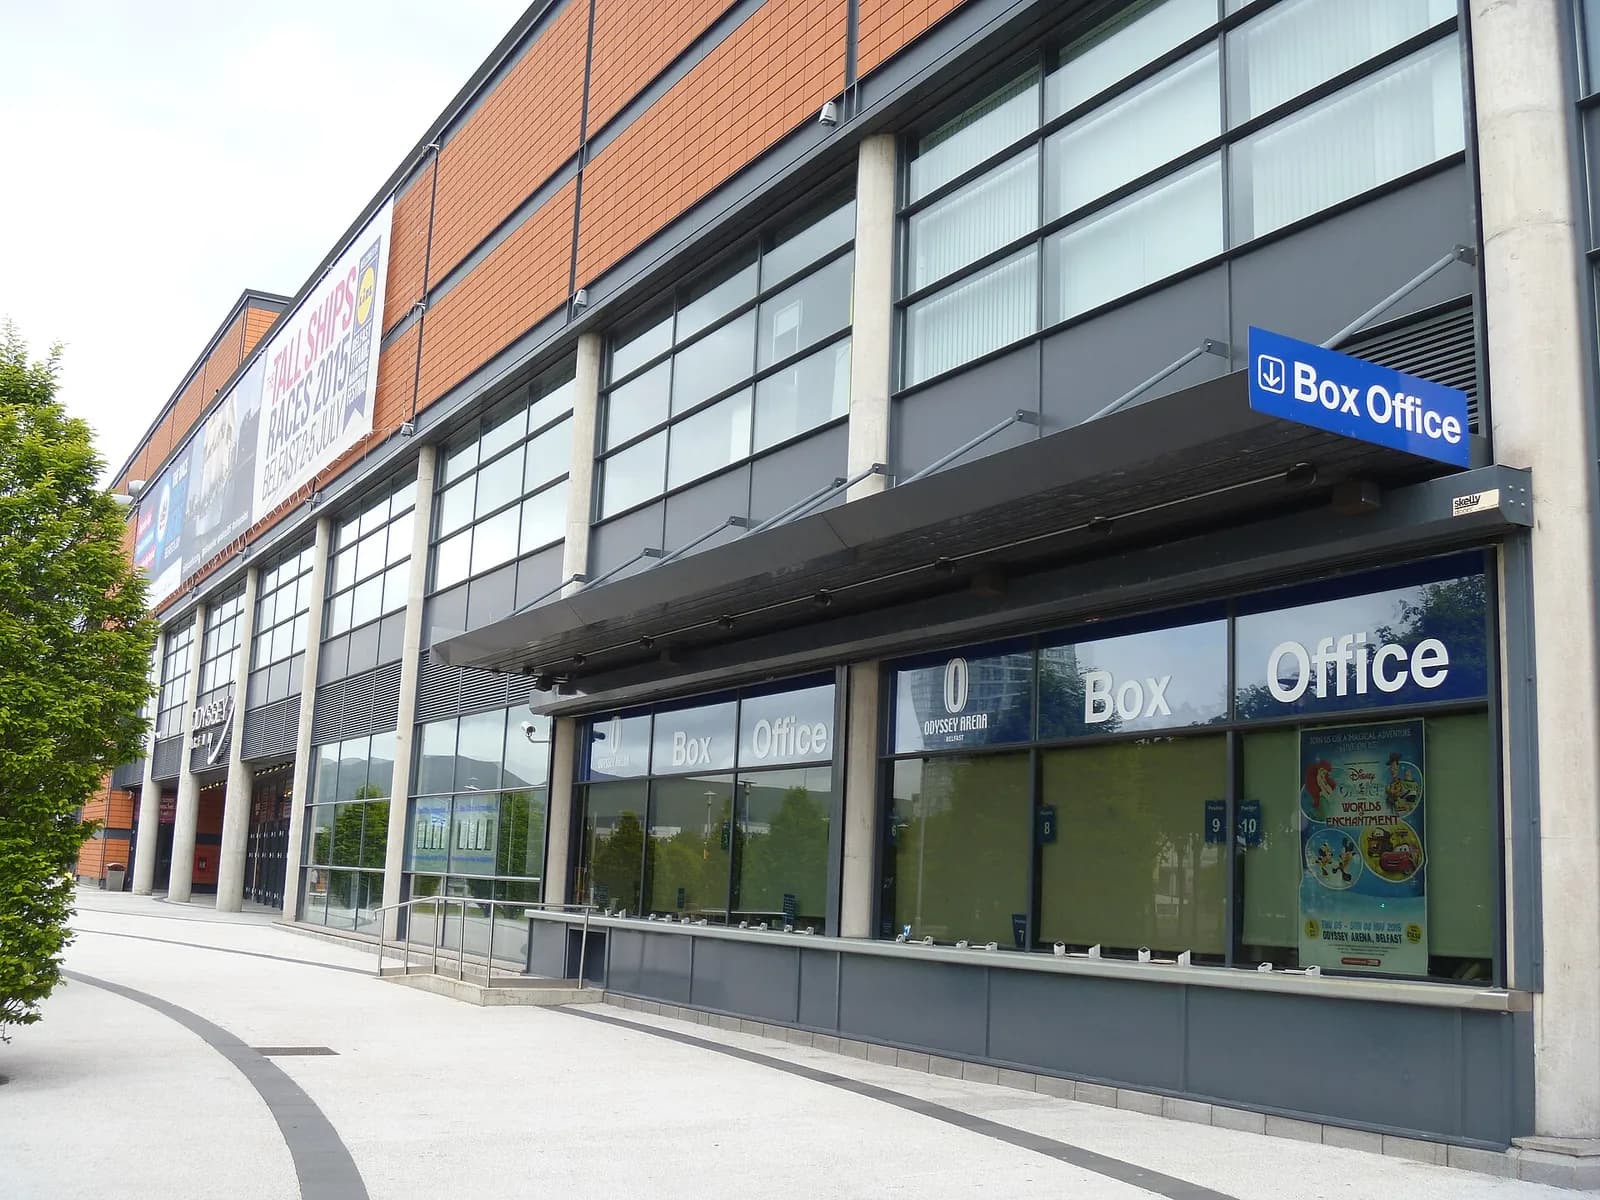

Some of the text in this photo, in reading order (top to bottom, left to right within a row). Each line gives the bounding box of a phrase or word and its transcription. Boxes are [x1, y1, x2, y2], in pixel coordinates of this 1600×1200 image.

[272, 265, 357, 406] TALL SHIPS
[266, 332, 350, 460] RACES 2015
[1294, 361, 1461, 444] Box Office
[262, 393, 345, 501] BELFAST 2-5 JULY
[1454, 494, 1480, 507] skelly
[1084, 633, 1450, 725] Box Office
[924, 713, 988, 736] ODYSSEY ARENA
[672, 713, 829, 767] Box Office
[945, 734, 964, 743] BELFAST
[1342, 801, 1381, 813] WORLDS
[1044, 822, 1050, 835] 8
[1212, 818, 1220, 833] 9
[1241, 818, 1257, 833] 10
[1327, 815, 1400, 827] ENCHANTMENT
[1018, 930, 1024, 942] 7
[1322, 930, 1348, 941] ODYSSEY
[1351, 932, 1374, 943] ARENA,
[1376, 933, 1402, 944] BELFAST
